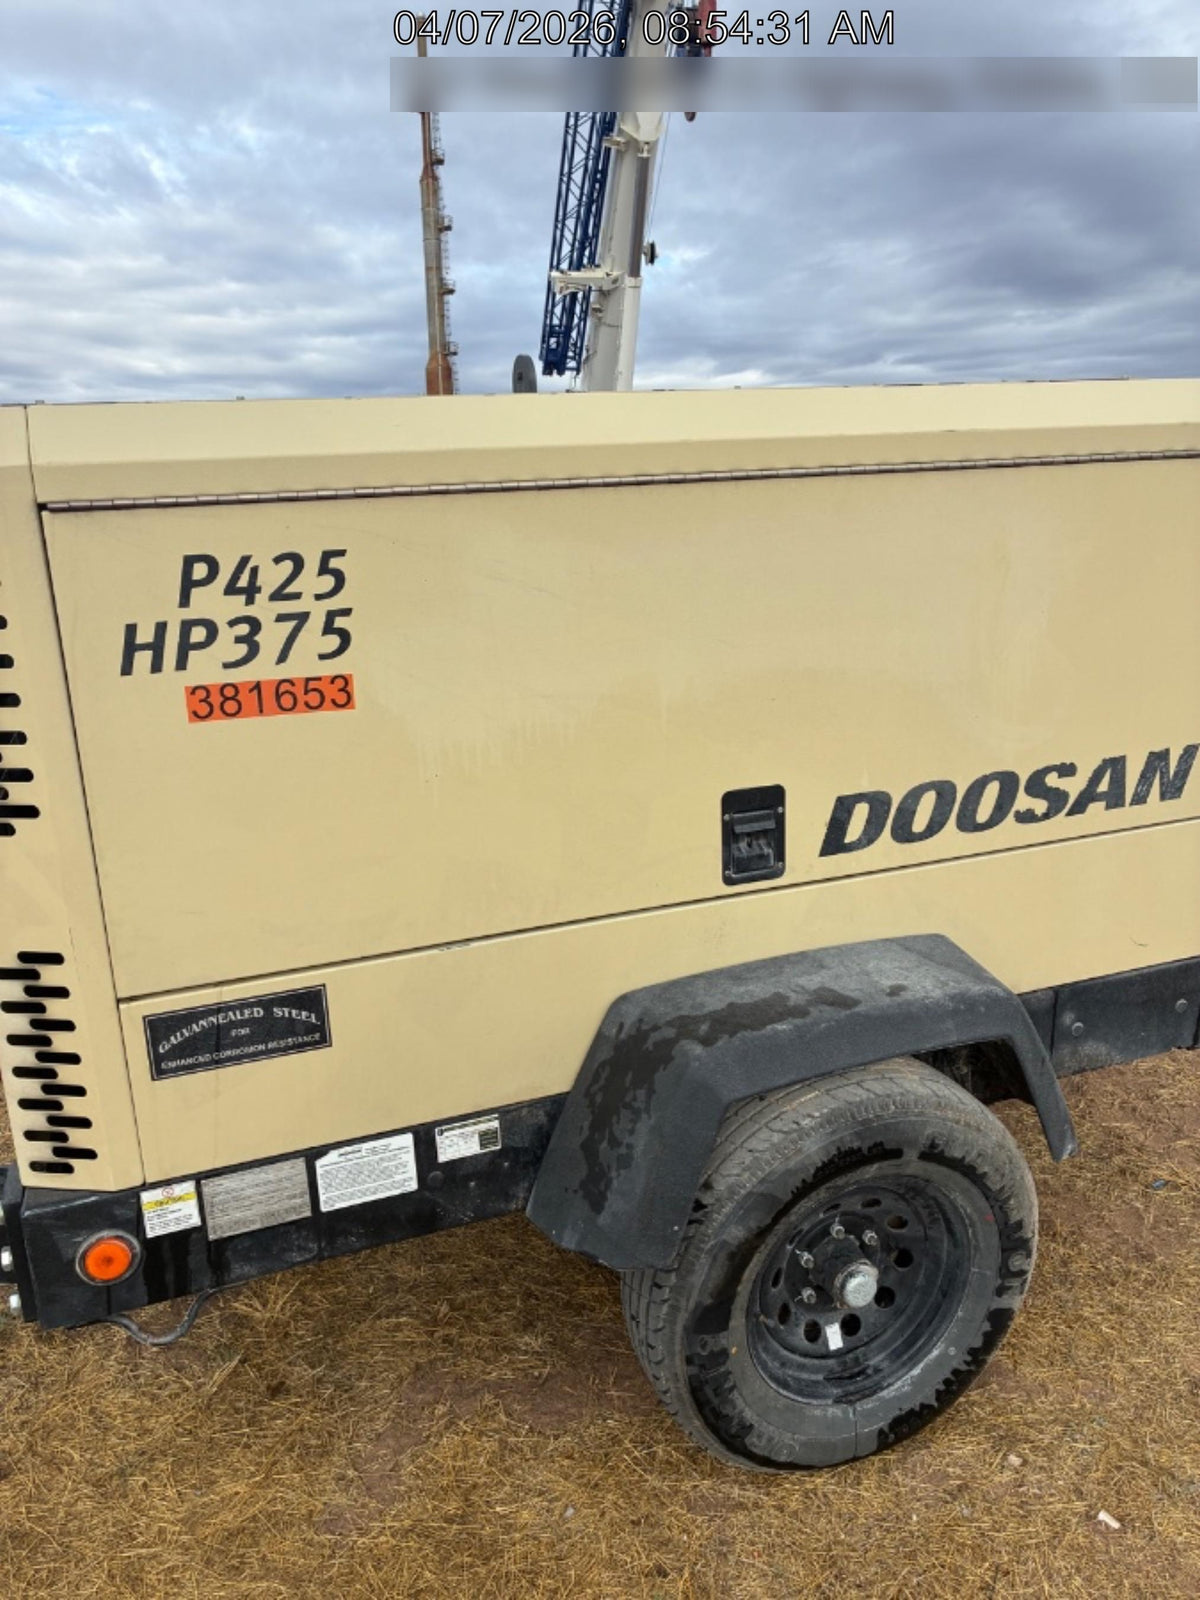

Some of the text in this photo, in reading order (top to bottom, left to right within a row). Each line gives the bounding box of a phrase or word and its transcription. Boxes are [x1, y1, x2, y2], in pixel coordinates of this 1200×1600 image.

[178, 549, 347, 608] P425
[120, 607, 353, 676] HP375
[190, 674, 352, 720] 381653
[819, 744, 1200, 857] DOOSAN
[158, 1007, 321, 1053] GALVANNEALED STEEL
